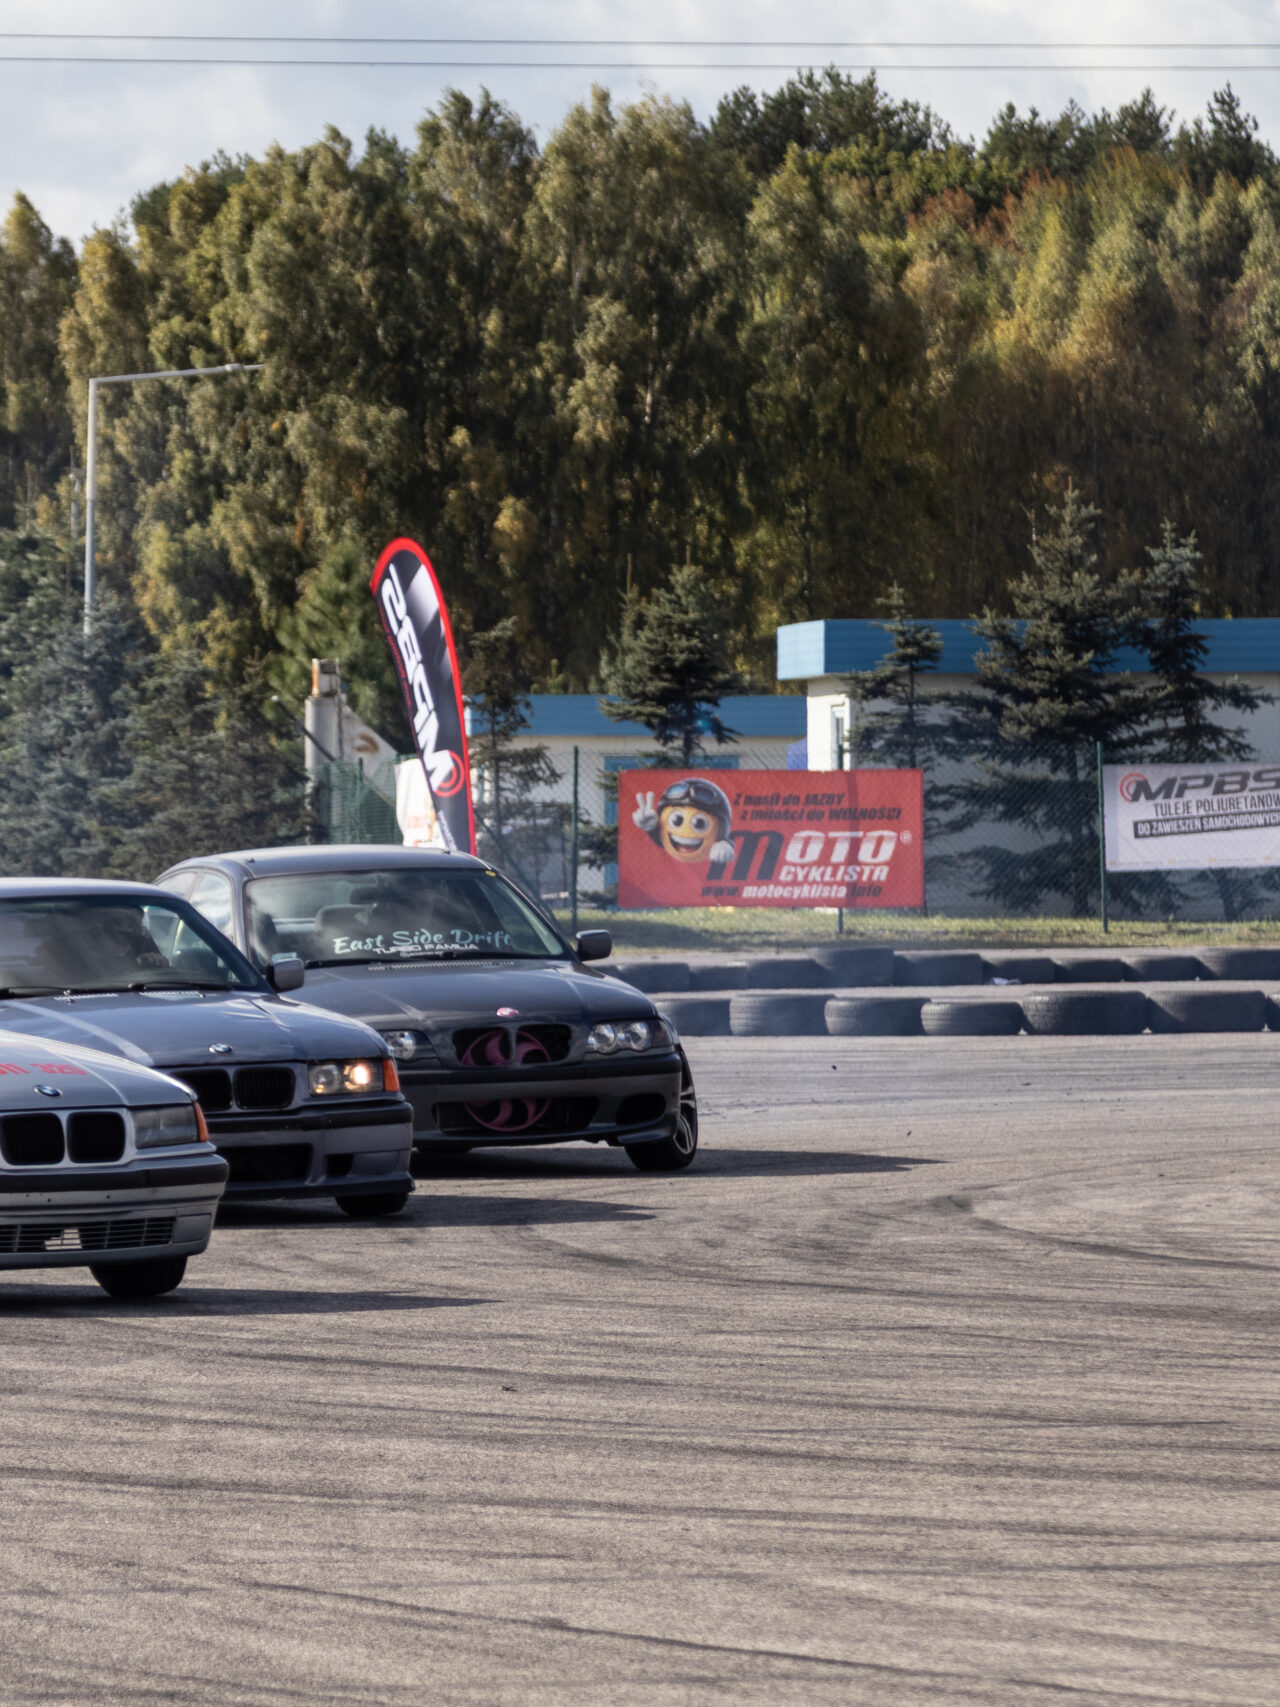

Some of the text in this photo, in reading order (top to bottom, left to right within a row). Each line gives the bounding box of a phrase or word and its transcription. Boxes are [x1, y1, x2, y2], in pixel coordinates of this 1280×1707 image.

[1130, 768, 1280, 802] MPBS
[744, 793, 780, 806] pasji
[782, 794, 800, 806] do
[803, 793, 845, 806] JAZDY
[806, 808, 825, 821] do
[828, 806, 901, 821] WOLNOŚCI
[1153, 801, 1193, 817] TULEJE
[1138, 822, 1151, 837] DO
[779, 865, 889, 882] CYKLISTA
[333, 928, 511, 954] East Side Drift
